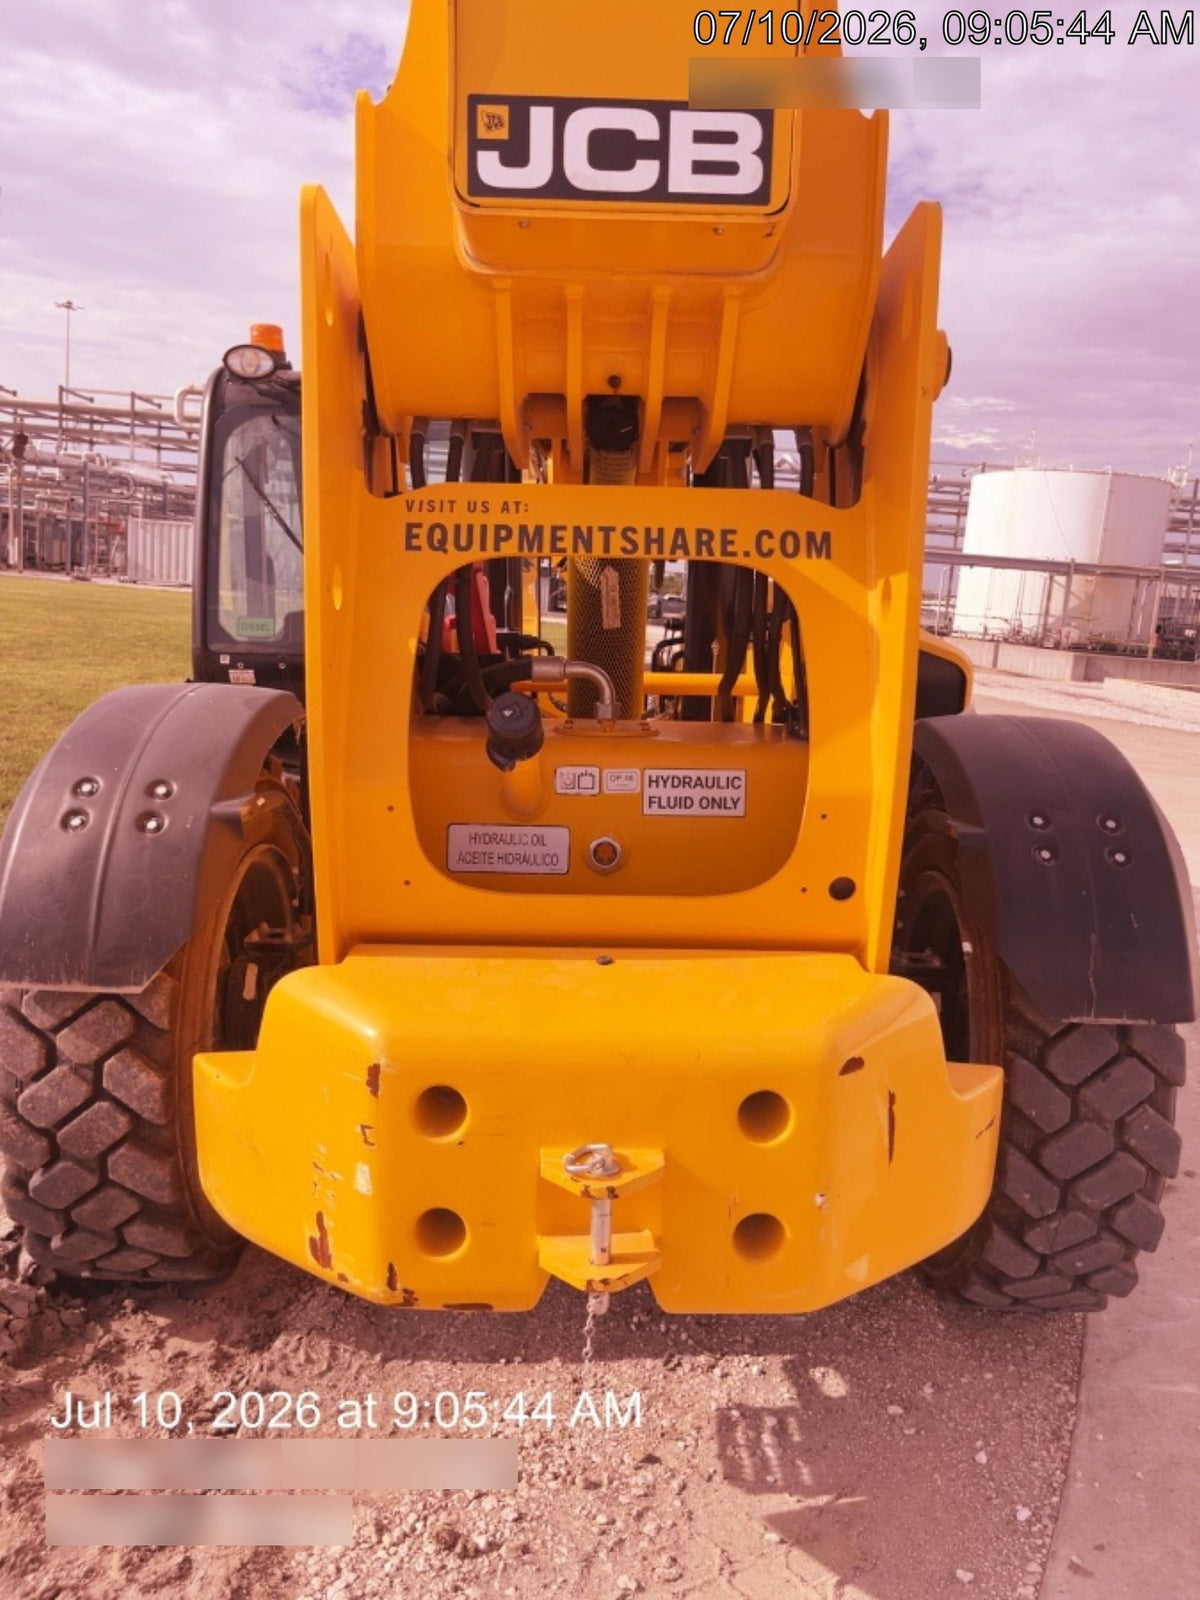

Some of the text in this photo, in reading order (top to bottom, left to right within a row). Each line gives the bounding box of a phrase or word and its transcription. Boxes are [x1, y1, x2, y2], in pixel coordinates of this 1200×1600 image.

[476, 105, 765, 196] JCB
[405, 499, 529, 515] VISIT US AT:
[404, 522, 833, 560] EQUIPMENTSHARE.COM
[647, 774, 742, 791] HYDRAULIC
[647, 796, 741, 811] FLUID ONLY
[468, 831, 548, 847] HYDRAULIC OIL
[456, 849, 496, 866] ACEITE
